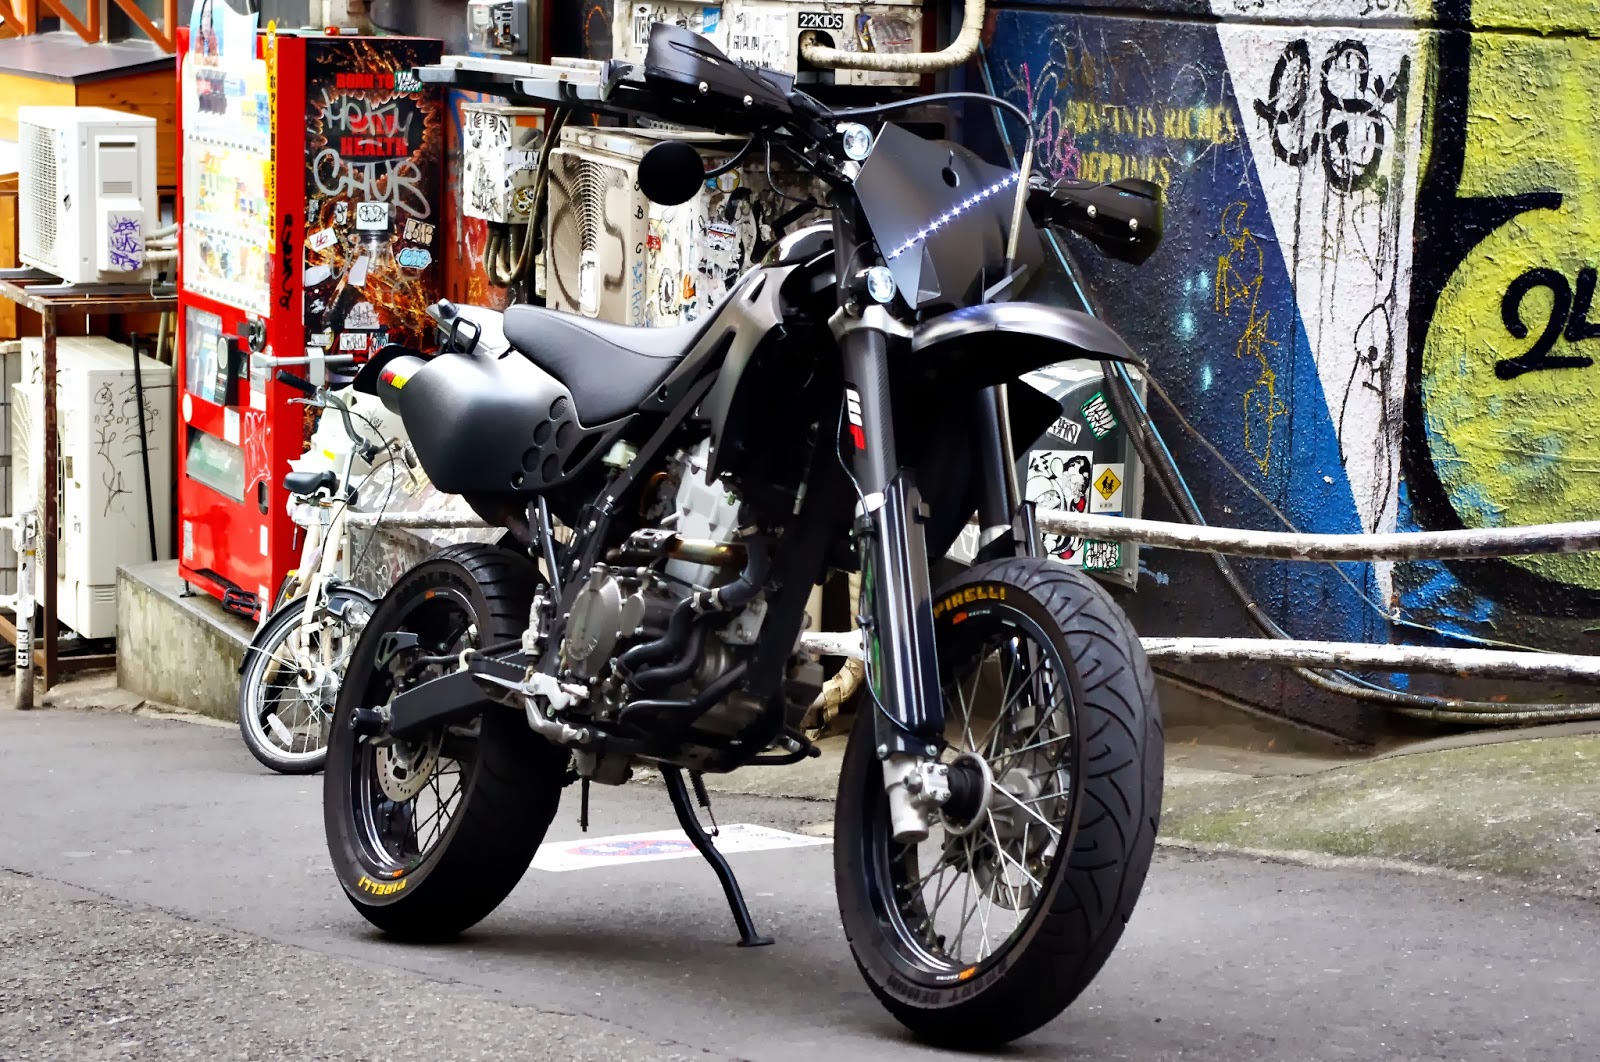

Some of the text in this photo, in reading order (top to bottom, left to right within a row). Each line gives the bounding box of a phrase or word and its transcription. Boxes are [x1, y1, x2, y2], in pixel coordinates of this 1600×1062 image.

[799, 13, 843, 29] 22KIDS
[340, 137, 408, 157] HEALTH
[933, 586, 1006, 618] PIRELLI
[357, 875, 408, 895] PIRELLI
